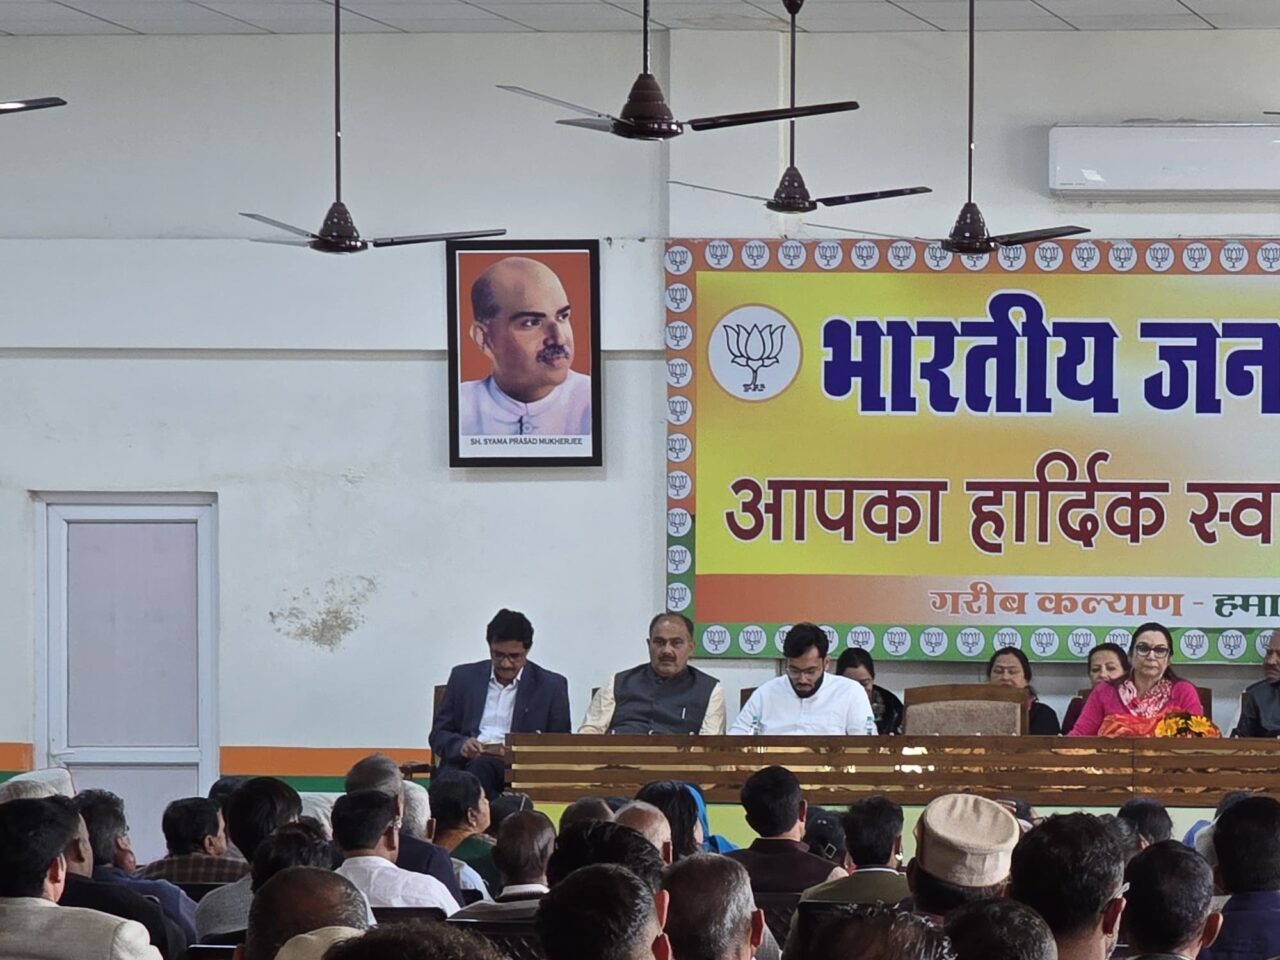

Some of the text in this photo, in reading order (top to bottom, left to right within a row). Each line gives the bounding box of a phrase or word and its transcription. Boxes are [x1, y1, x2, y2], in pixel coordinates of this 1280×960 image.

[822, 292, 1120, 414] भारतीय
[725, 478, 949, 542] आपका
[965, 451, 1170, 554] हार्दिक
[929, 581, 1029, 615] गरीब
[1035, 592, 1185, 617] कल्याण
